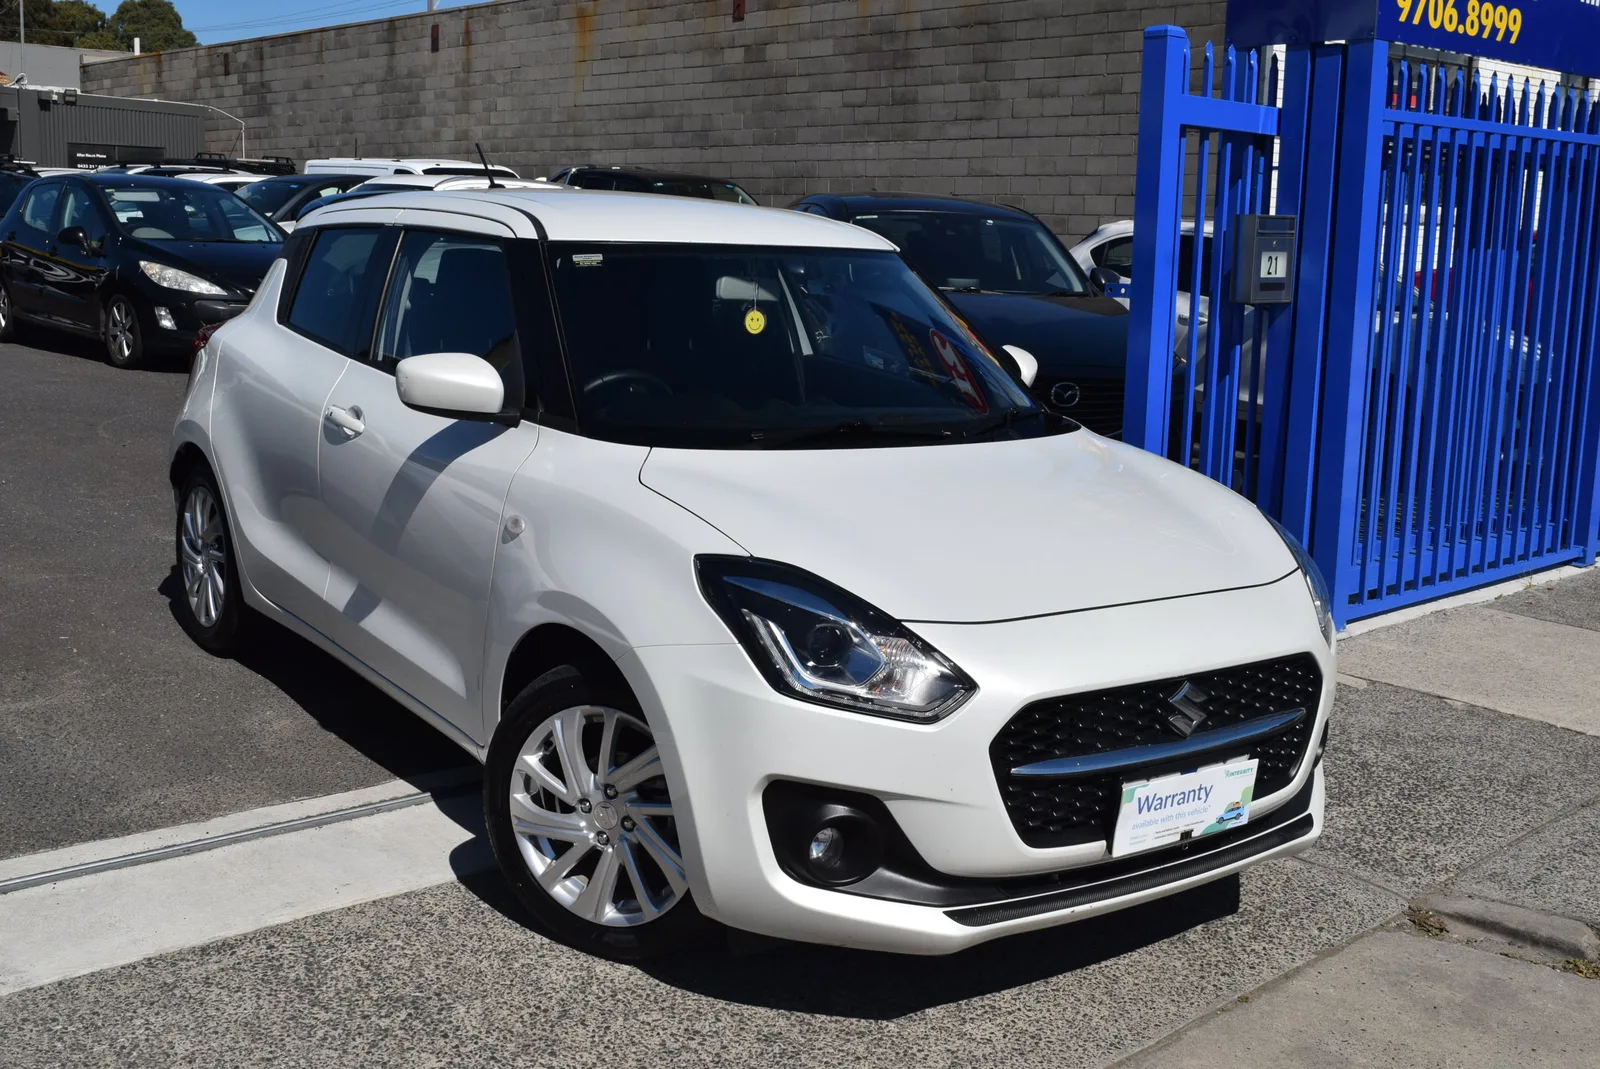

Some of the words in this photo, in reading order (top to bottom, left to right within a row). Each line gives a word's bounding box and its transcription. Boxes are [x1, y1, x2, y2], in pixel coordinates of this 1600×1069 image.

[1396, 0, 1523, 44] 9706.8999
[1267, 255, 1279, 275] 21
[1137, 783, 1214, 815] Warranty
[1131, 817, 1160, 831] available
[1160, 814, 1174, 824] with
[1174, 811, 1187, 821] this
